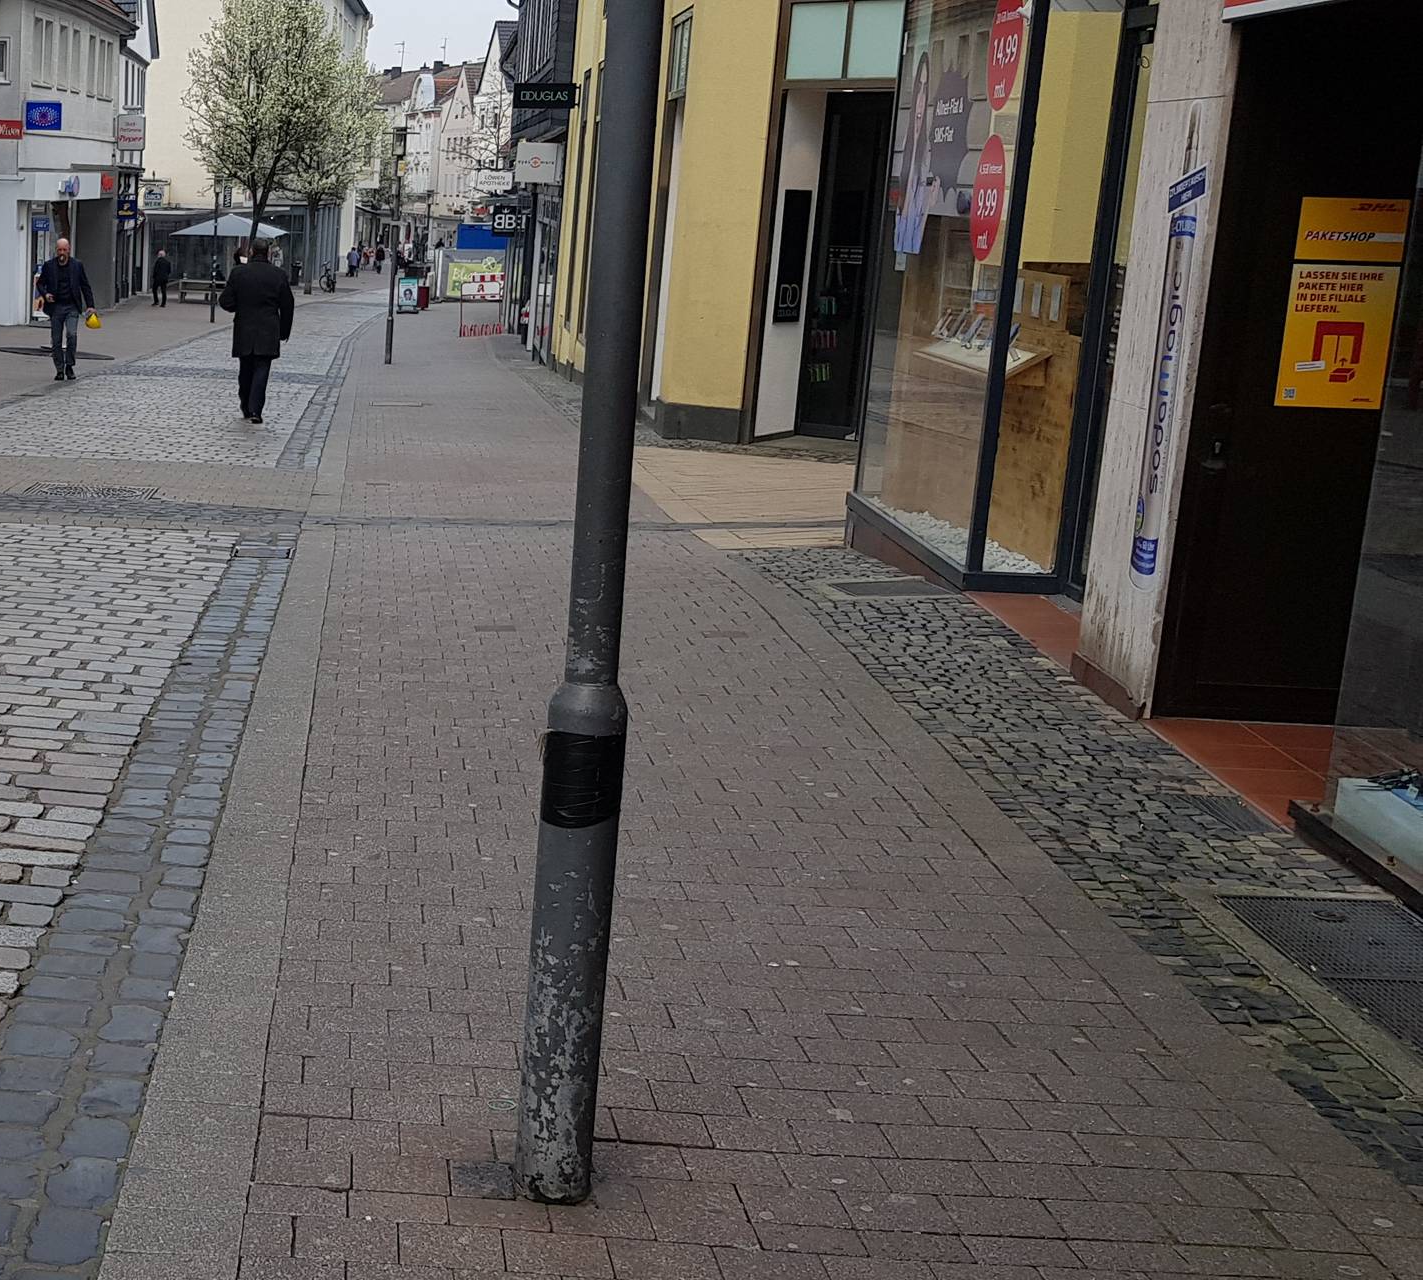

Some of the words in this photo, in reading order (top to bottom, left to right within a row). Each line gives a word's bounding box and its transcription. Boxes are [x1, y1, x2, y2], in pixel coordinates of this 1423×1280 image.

[993, 34, 1018, 68] 14,99
[977, 188, 997, 220] 9,99
[1304, 230, 1376, 242] PAKETSHOP
[1299, 271, 1338, 280] LASSEN
[1341, 272, 1359, 280] SIE
[1360, 272, 1384, 281] IHRE
[1298, 282, 1336, 291] PAKETE
[1339, 283, 1363, 292] HIER
[1296, 293, 1307, 302] IN
[1310, 293, 1326, 302] DIE
[1329, 294, 1366, 303] FILIALE
[1295, 304, 1340, 313] LIEFERN.
